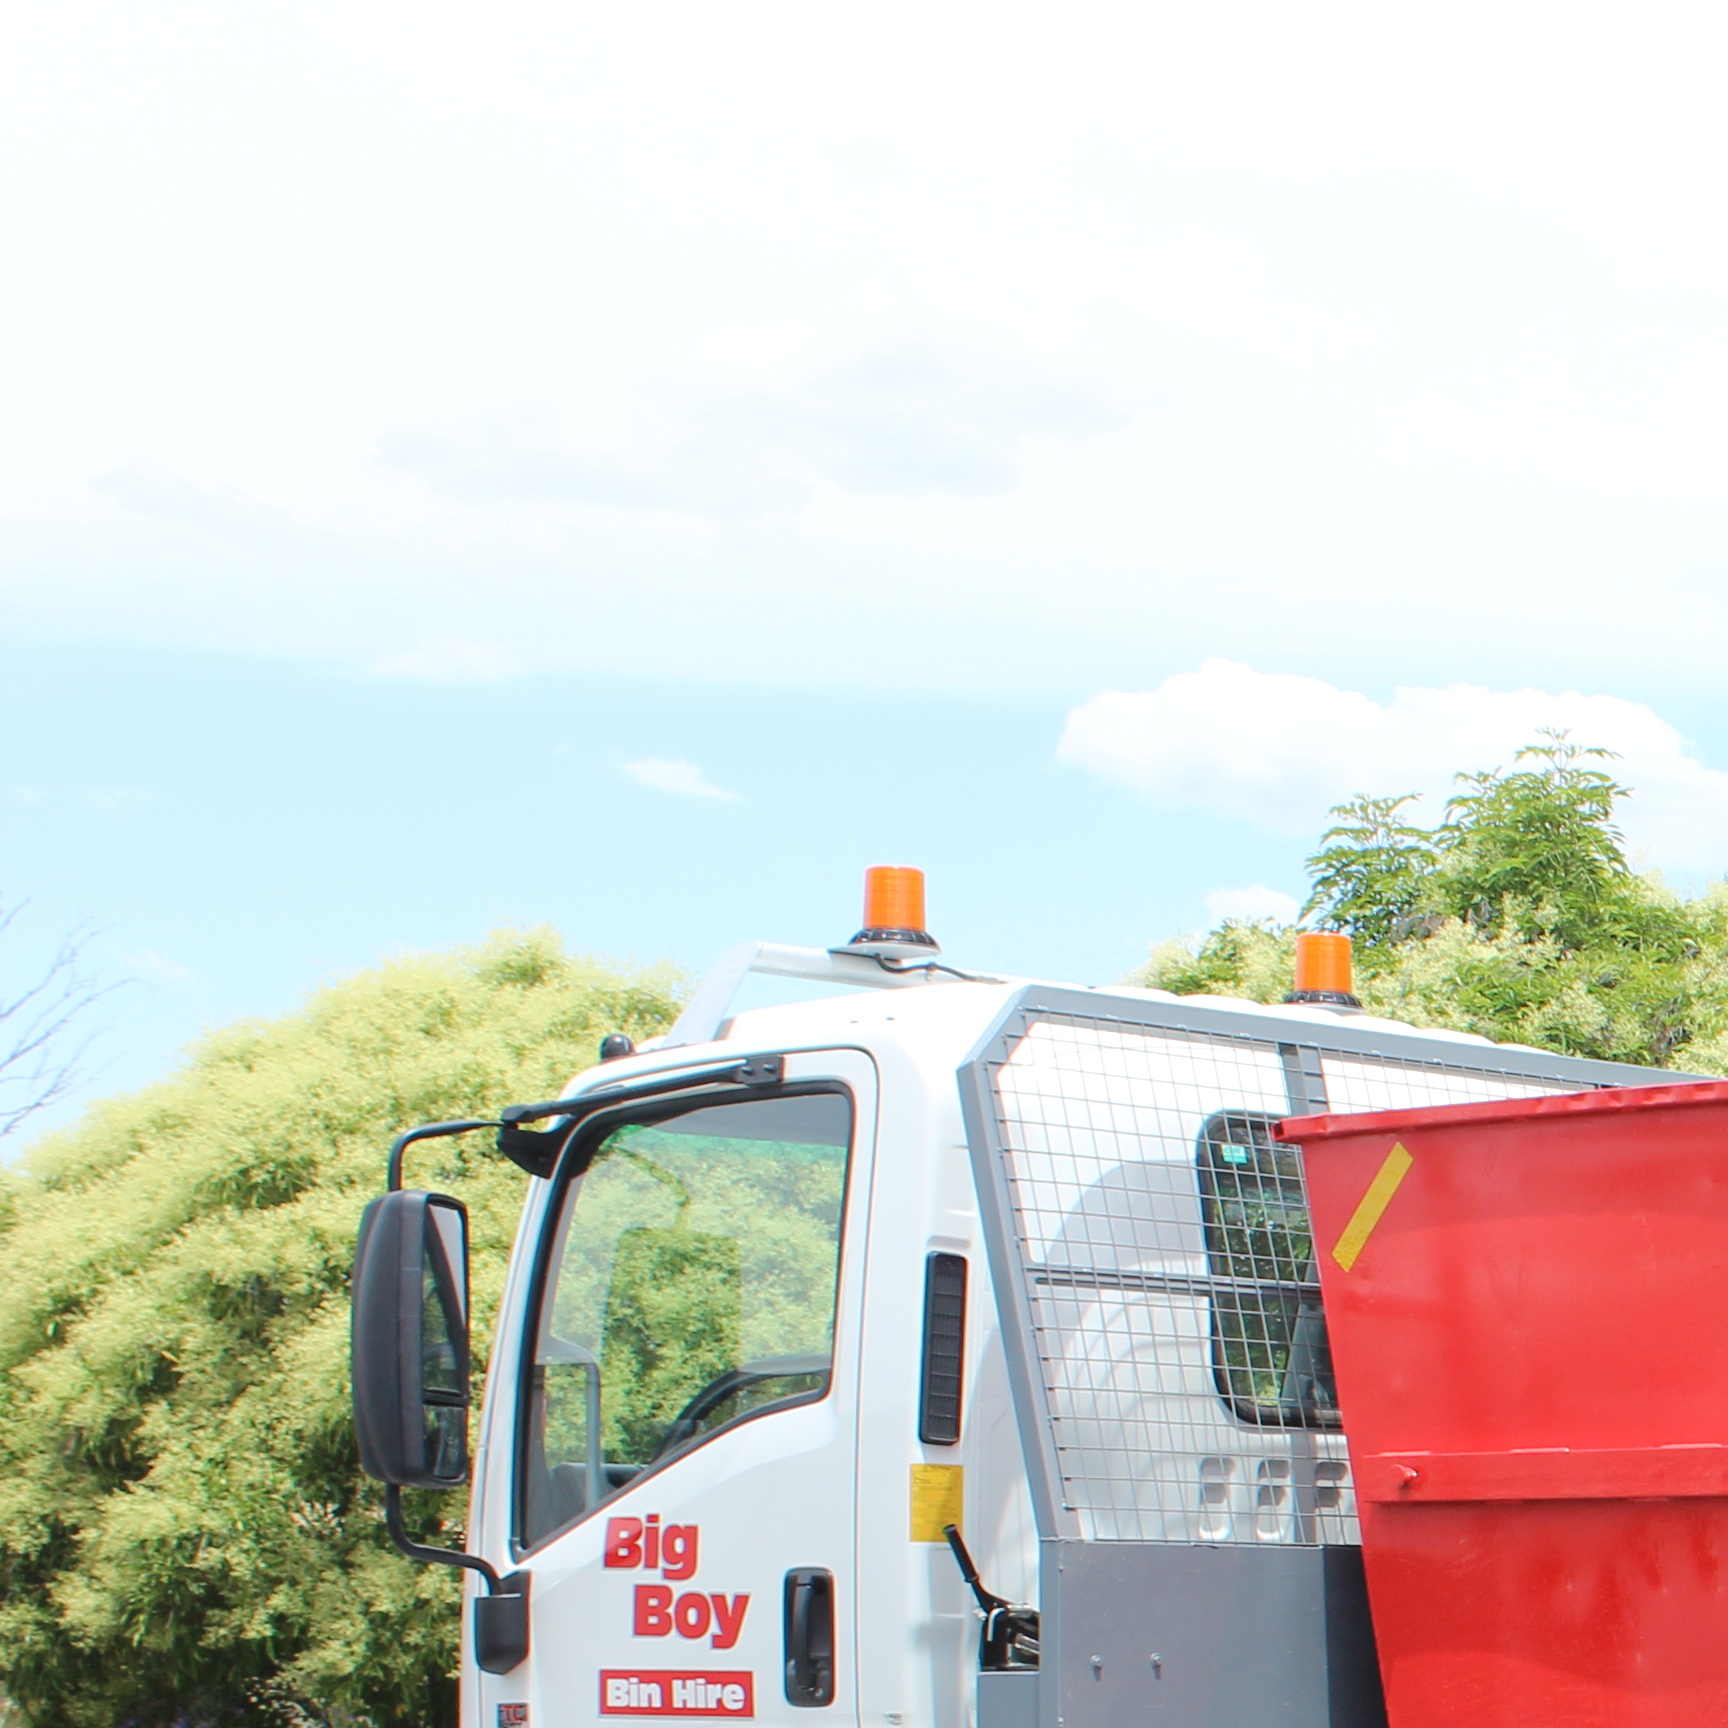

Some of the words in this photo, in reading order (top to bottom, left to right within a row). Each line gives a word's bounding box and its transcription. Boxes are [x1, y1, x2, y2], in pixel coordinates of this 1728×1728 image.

[604, 1513, 699, 1580] Big
[633, 1584, 751, 1650] Boy
[606, 1677, 662, 1708] Bin
[672, 1678, 745, 1710] Hire
